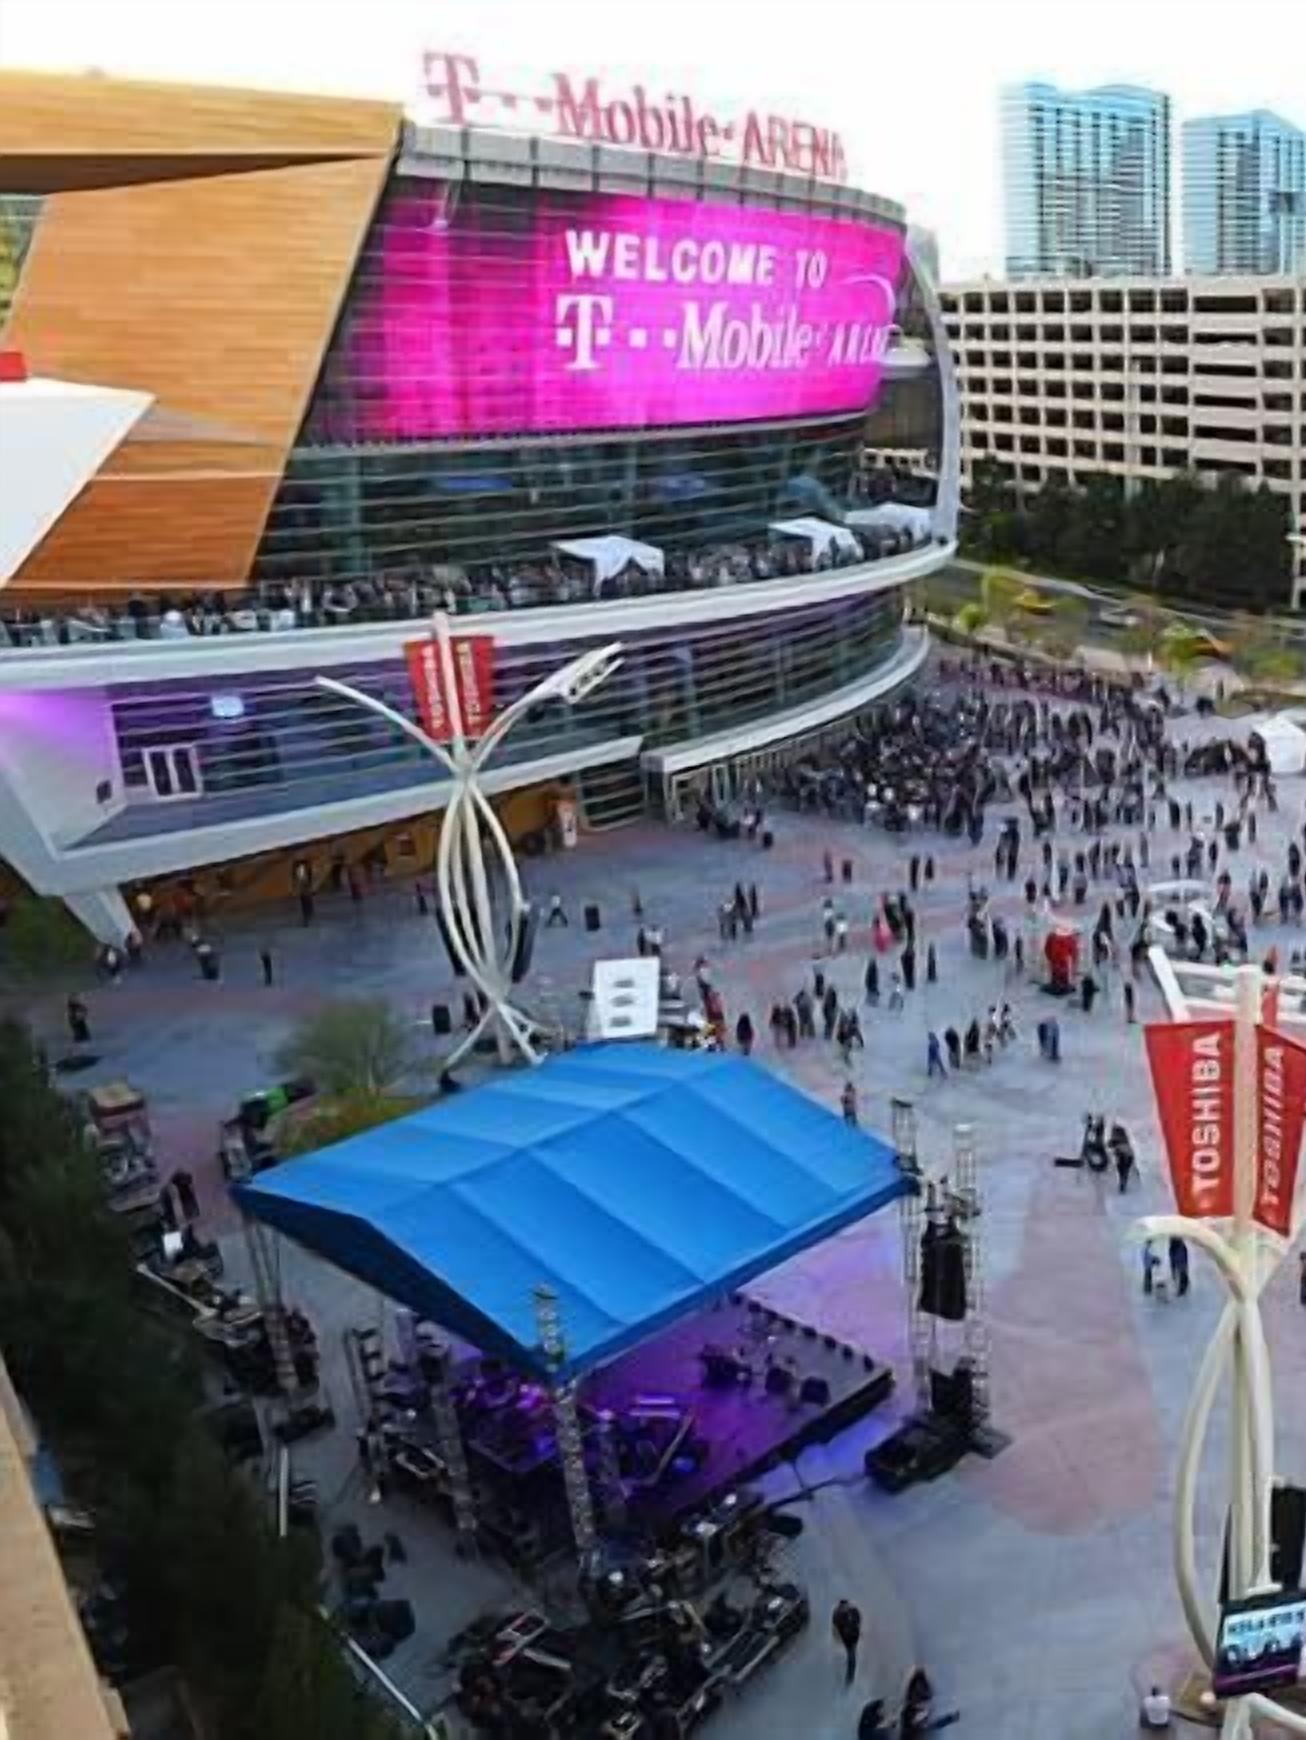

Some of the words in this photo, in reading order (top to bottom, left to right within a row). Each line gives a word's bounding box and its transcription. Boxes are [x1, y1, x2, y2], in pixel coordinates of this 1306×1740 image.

[566, 228, 777, 285] WELCOME
[796, 249, 828, 288] TO
[1191, 1031, 1222, 1196] TOSHIBA
[1260, 1045, 1285, 1206] TOSHIBA
